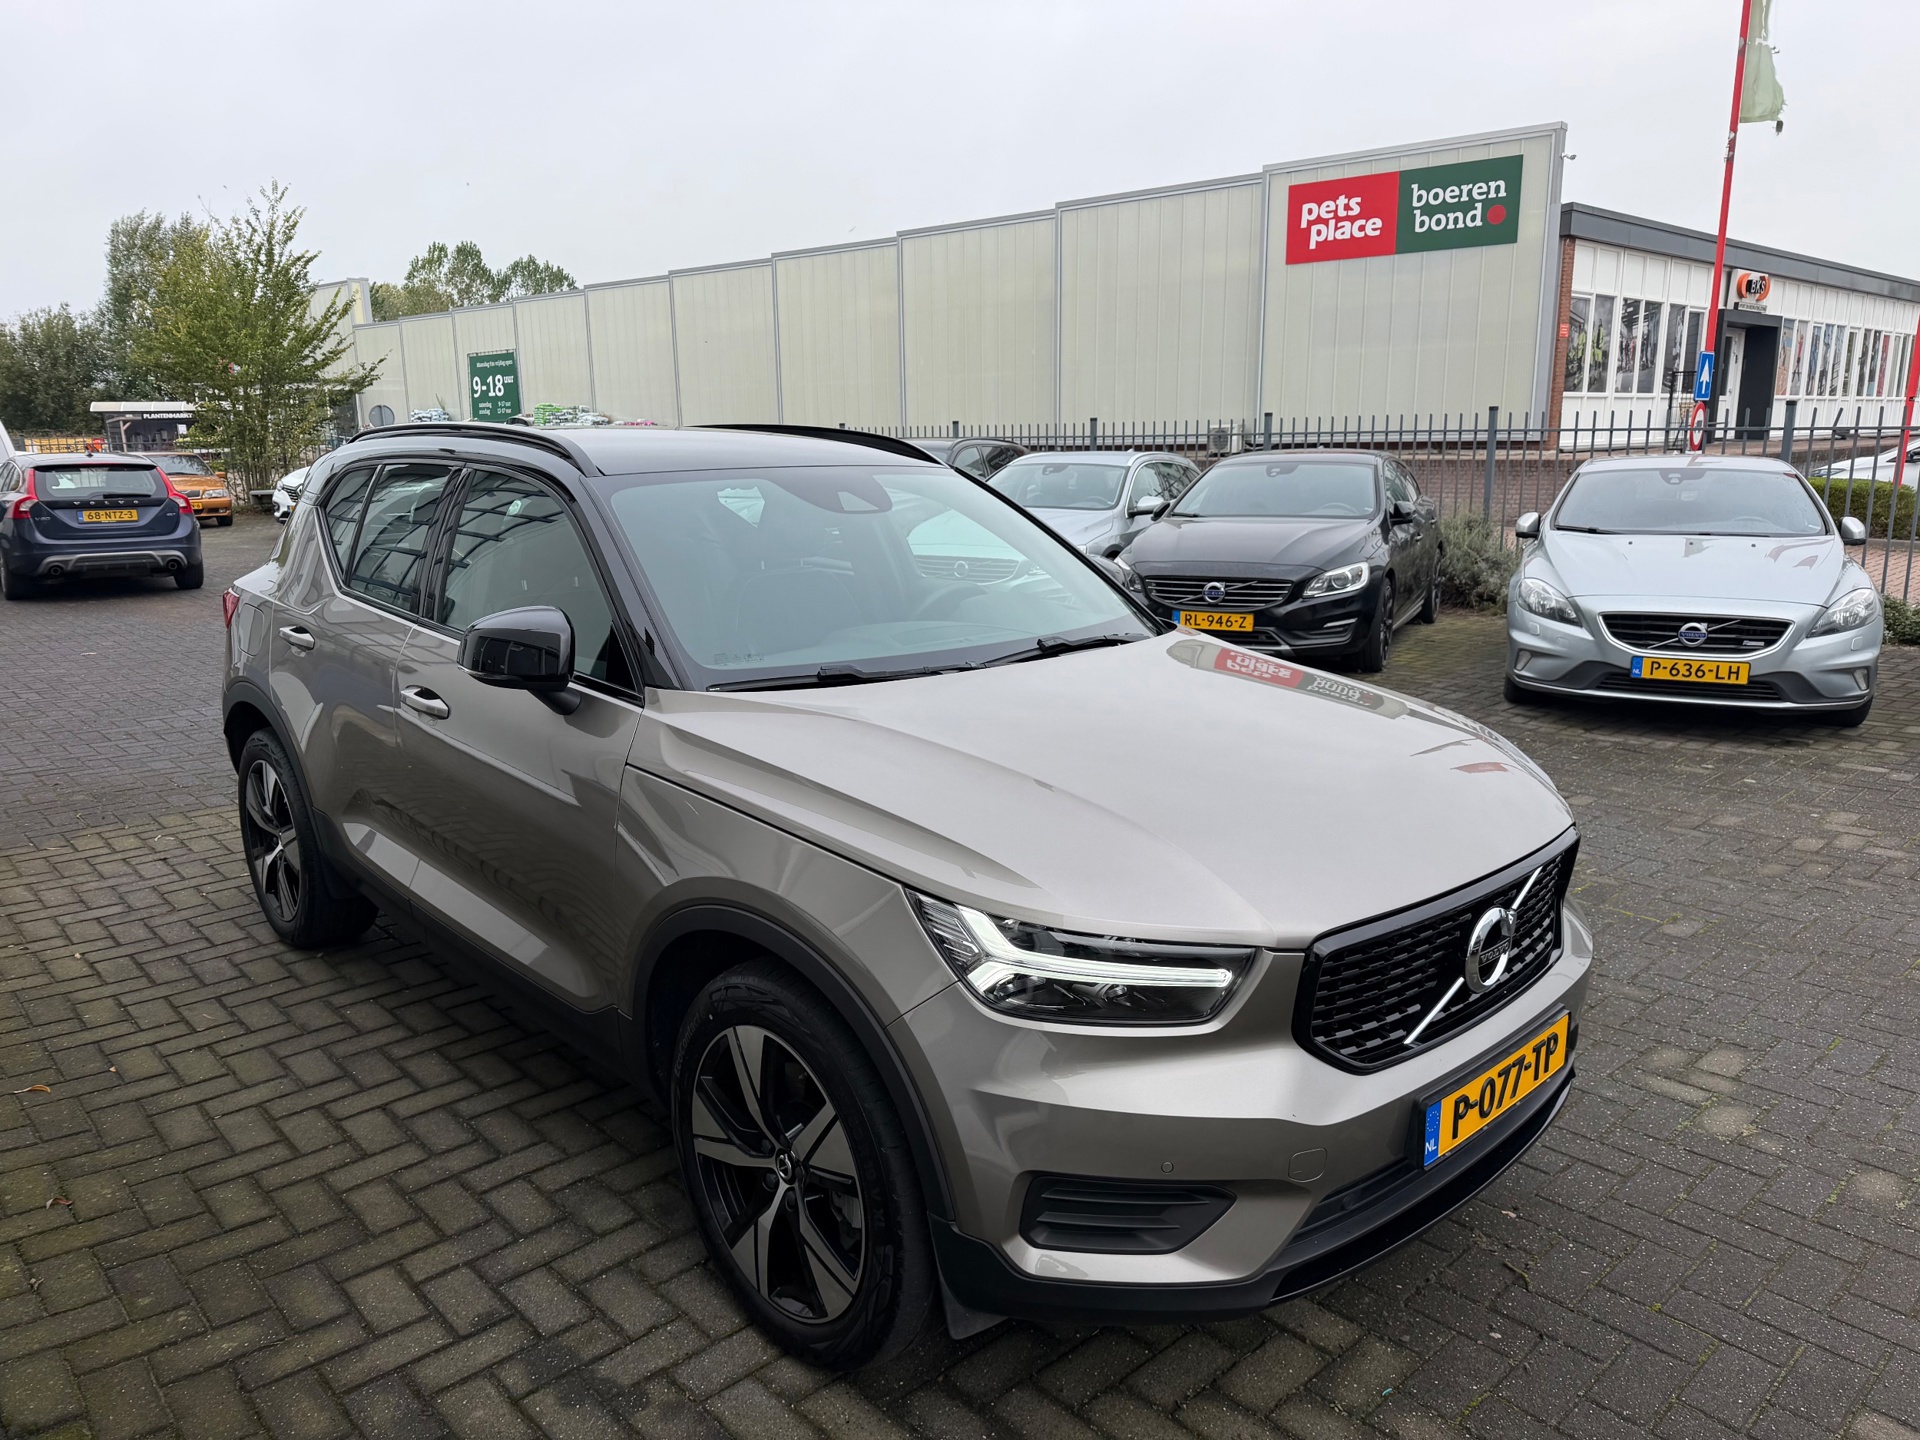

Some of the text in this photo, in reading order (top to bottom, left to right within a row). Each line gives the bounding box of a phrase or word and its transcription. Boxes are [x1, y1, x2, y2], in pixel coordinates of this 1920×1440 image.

[1411, 179, 1507, 208] boeren
[1300, 194, 1362, 229] pets
[1413, 203, 1483, 233] bond
[1308, 217, 1383, 250] place
[472, 374, 505, 398] 9-18
[86, 509, 134, 521] 68-NTZ-3
[1184, 613, 1247, 628] RL-946-Z
[1650, 660, 1741, 681] P-636-LH
[1480, 942, 1510, 963] VOLVO
[1452, 1031, 1559, 1140] P-077-TP
[1425, 1138, 1437, 1155] NL
